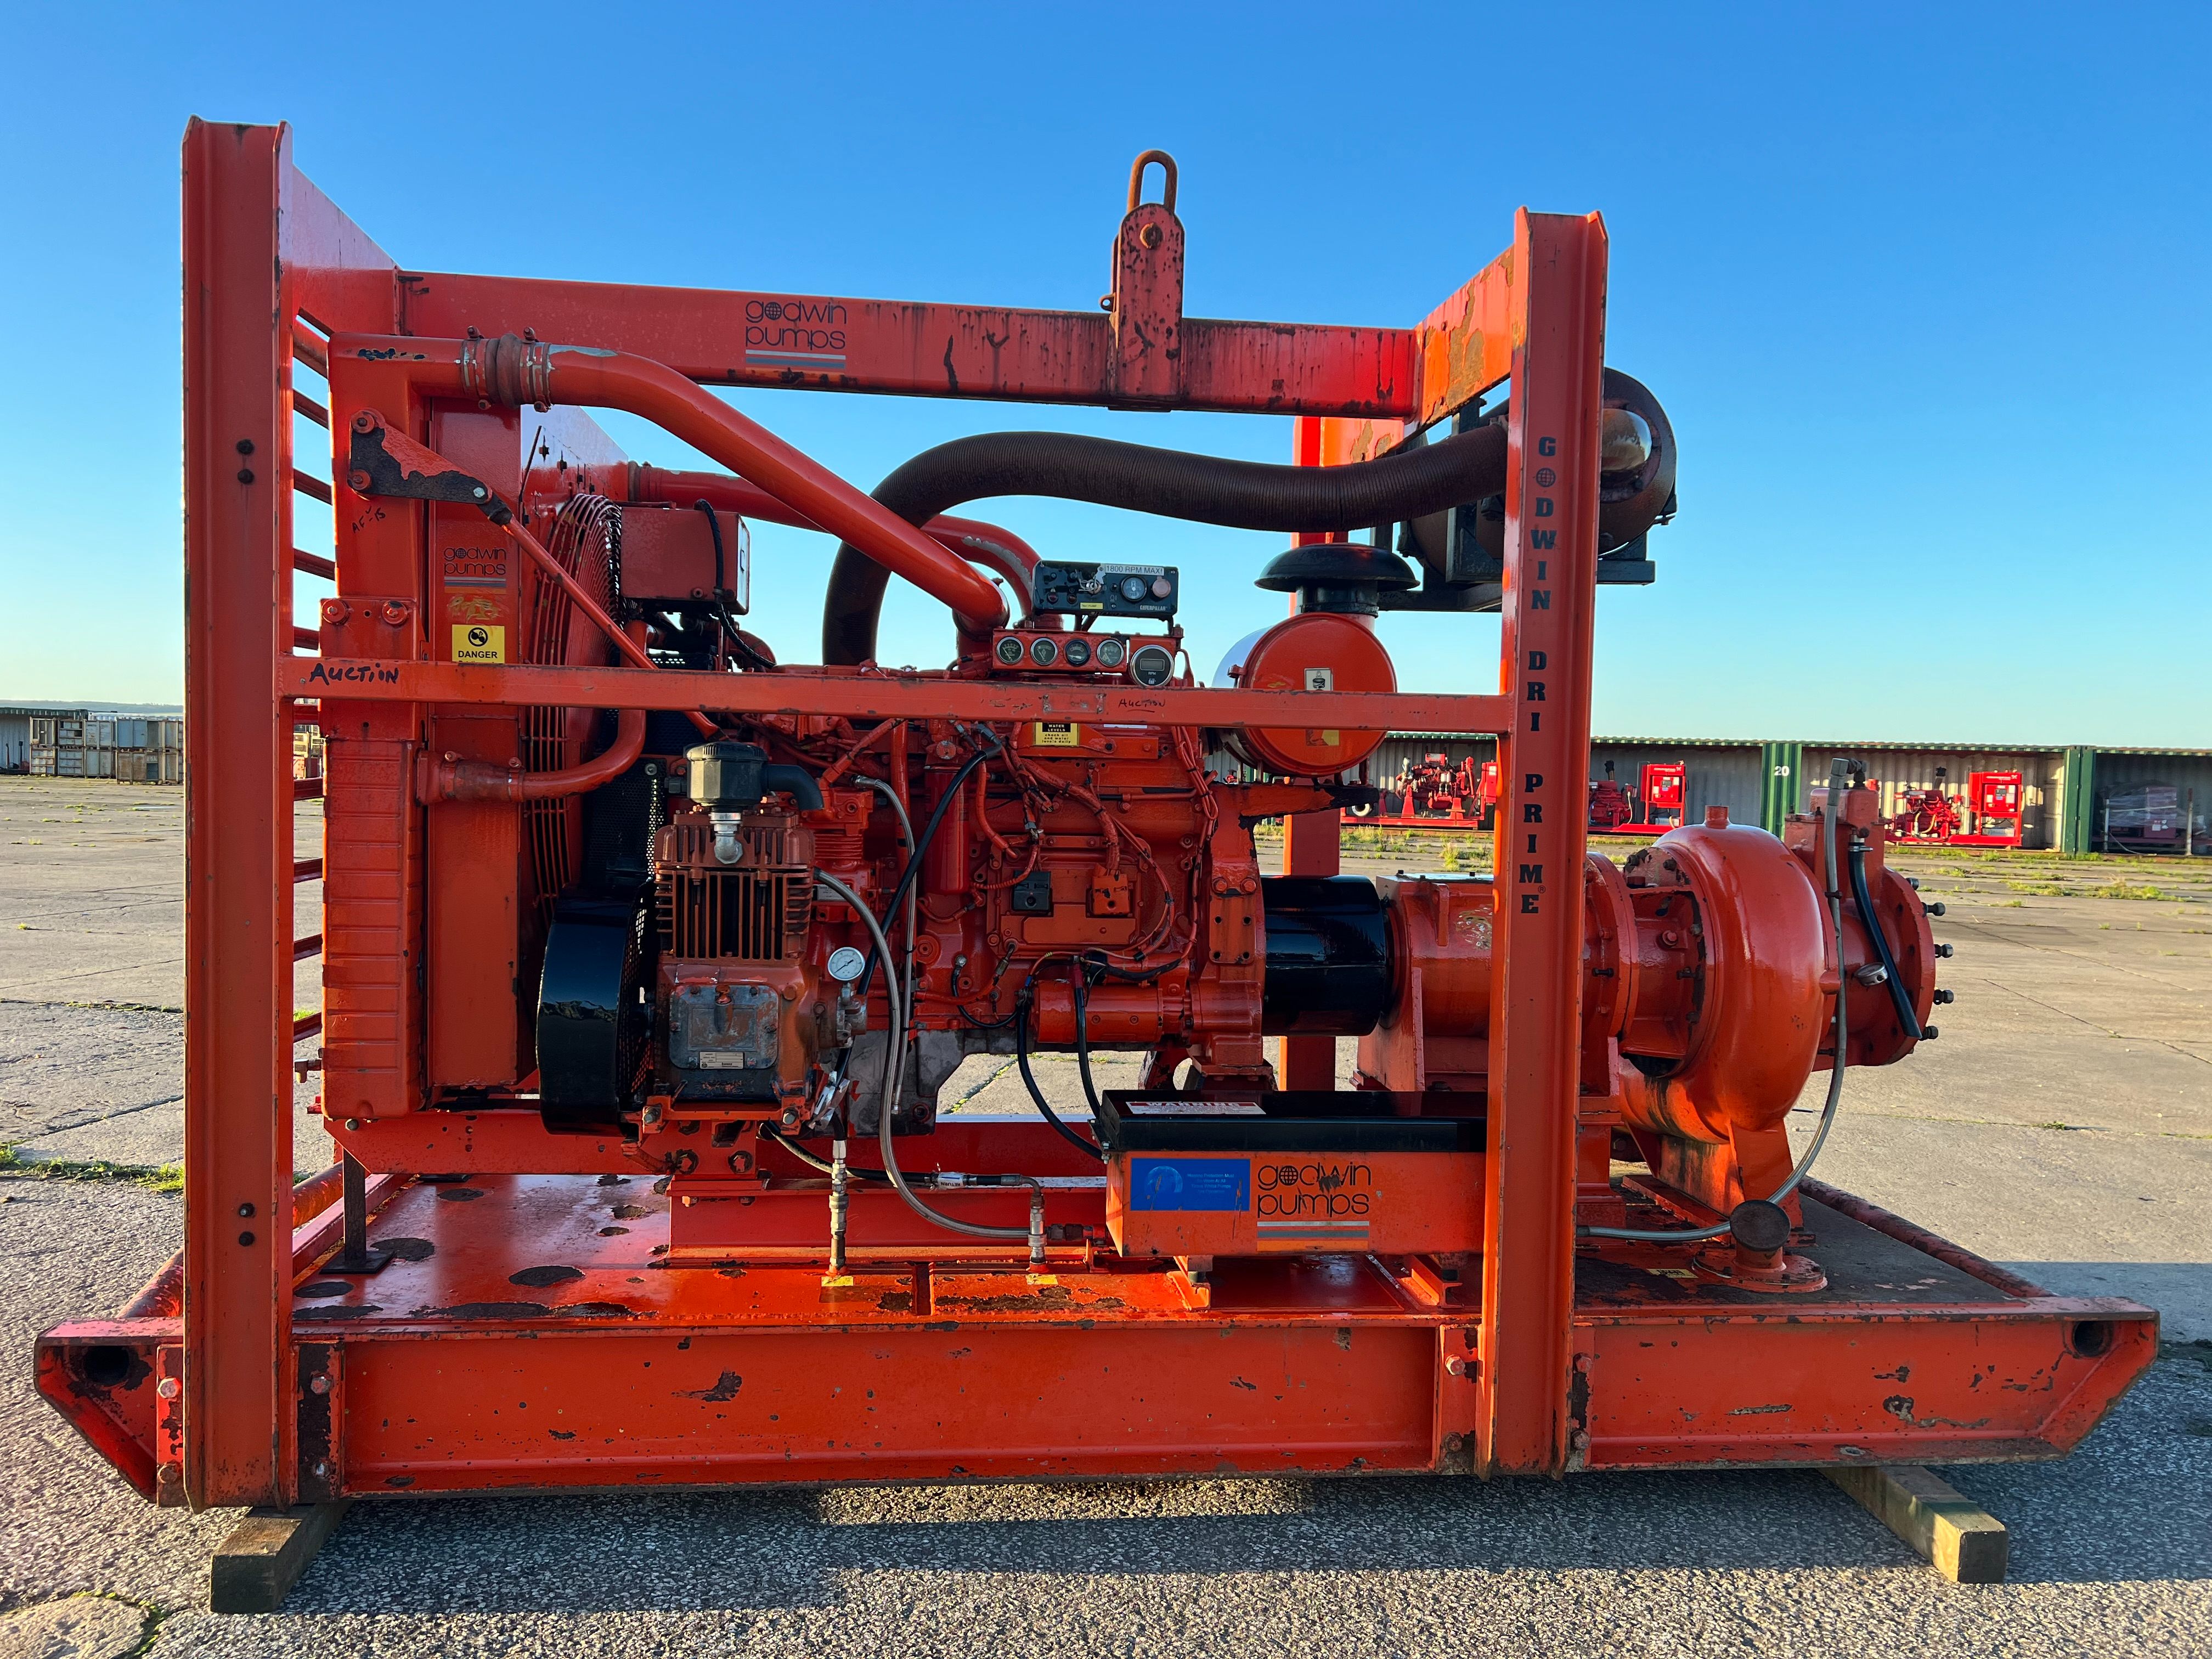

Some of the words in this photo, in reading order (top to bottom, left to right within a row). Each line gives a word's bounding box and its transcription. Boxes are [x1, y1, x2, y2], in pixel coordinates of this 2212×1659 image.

[746, 300, 847, 324] godwin
[746, 326, 846, 351] pumps
[1530, 436, 1557, 610] GODWIN
[443, 546, 506, 561] godwin
[444, 562, 506, 575] pumps
[458, 650, 498, 658] DANGER
[1527, 651, 1547, 732] DRI
[1774, 765, 1790, 777] 20
[1257, 1193, 1369, 1218] pumps
